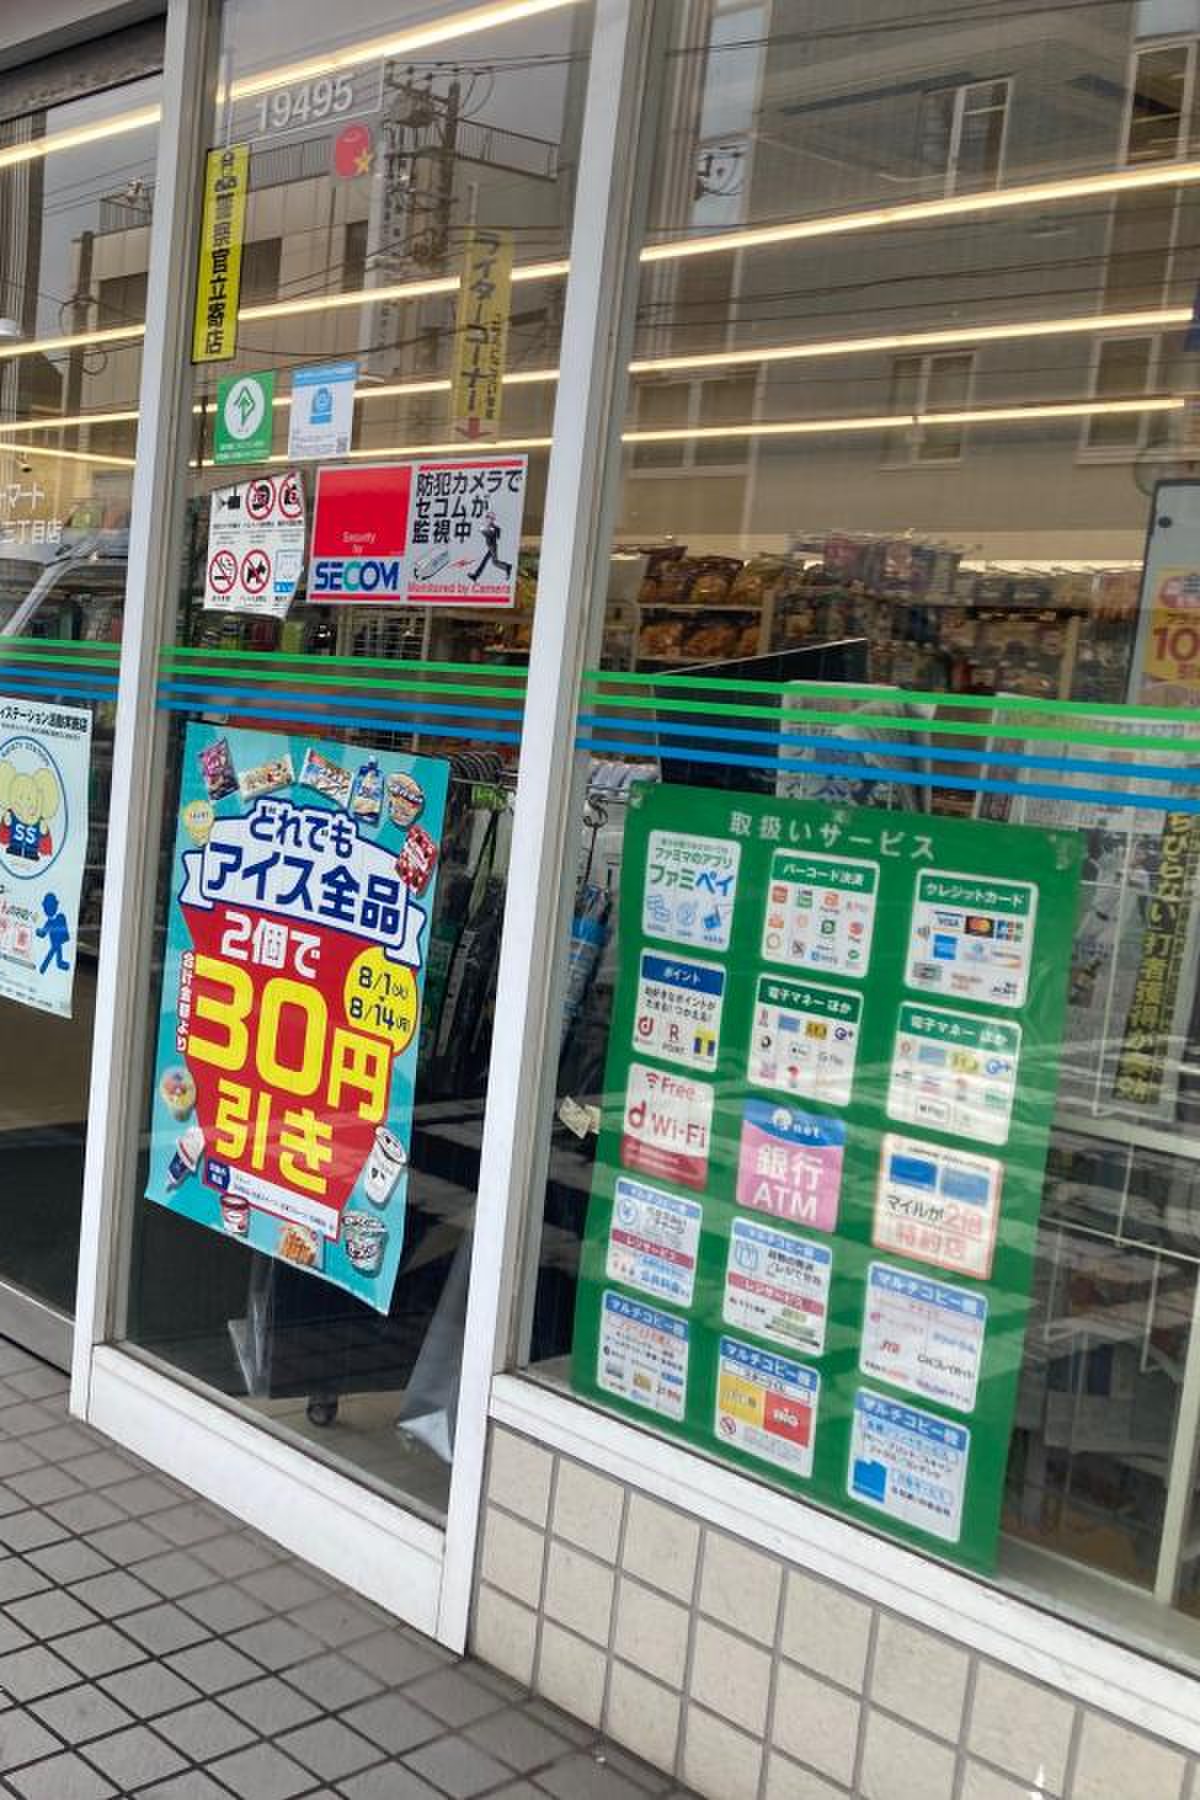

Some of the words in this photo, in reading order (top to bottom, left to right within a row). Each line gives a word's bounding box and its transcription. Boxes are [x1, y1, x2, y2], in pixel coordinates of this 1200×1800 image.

[256, 78, 353, 131] 19495
[416, 469, 523, 497] 防犯カメラで
[415, 496, 490, 520] セコムが
[411, 520, 472, 545] 監視中
[314, 560, 400, 592] SECOM
[14, 823, 38, 845] SS
[250, 804, 354, 860] どれでも
[729, 810, 936, 860] 取扱いサービス
[206, 842, 402, 935] アイス全品
[650, 863, 735, 897] ファミペイ
[926, 882, 1025, 907] クレジットカード
[220, 911, 322, 979] 2個で
[187, 952, 393, 1124] 30円
[662, 1077, 696, 1098] Free
[214, 1077, 333, 1195] 引き
[651, 1113, 705, 1149] Wi-Fi
[756, 1143, 824, 1191] 銀行
[752, 1181, 817, 1221] ATM
